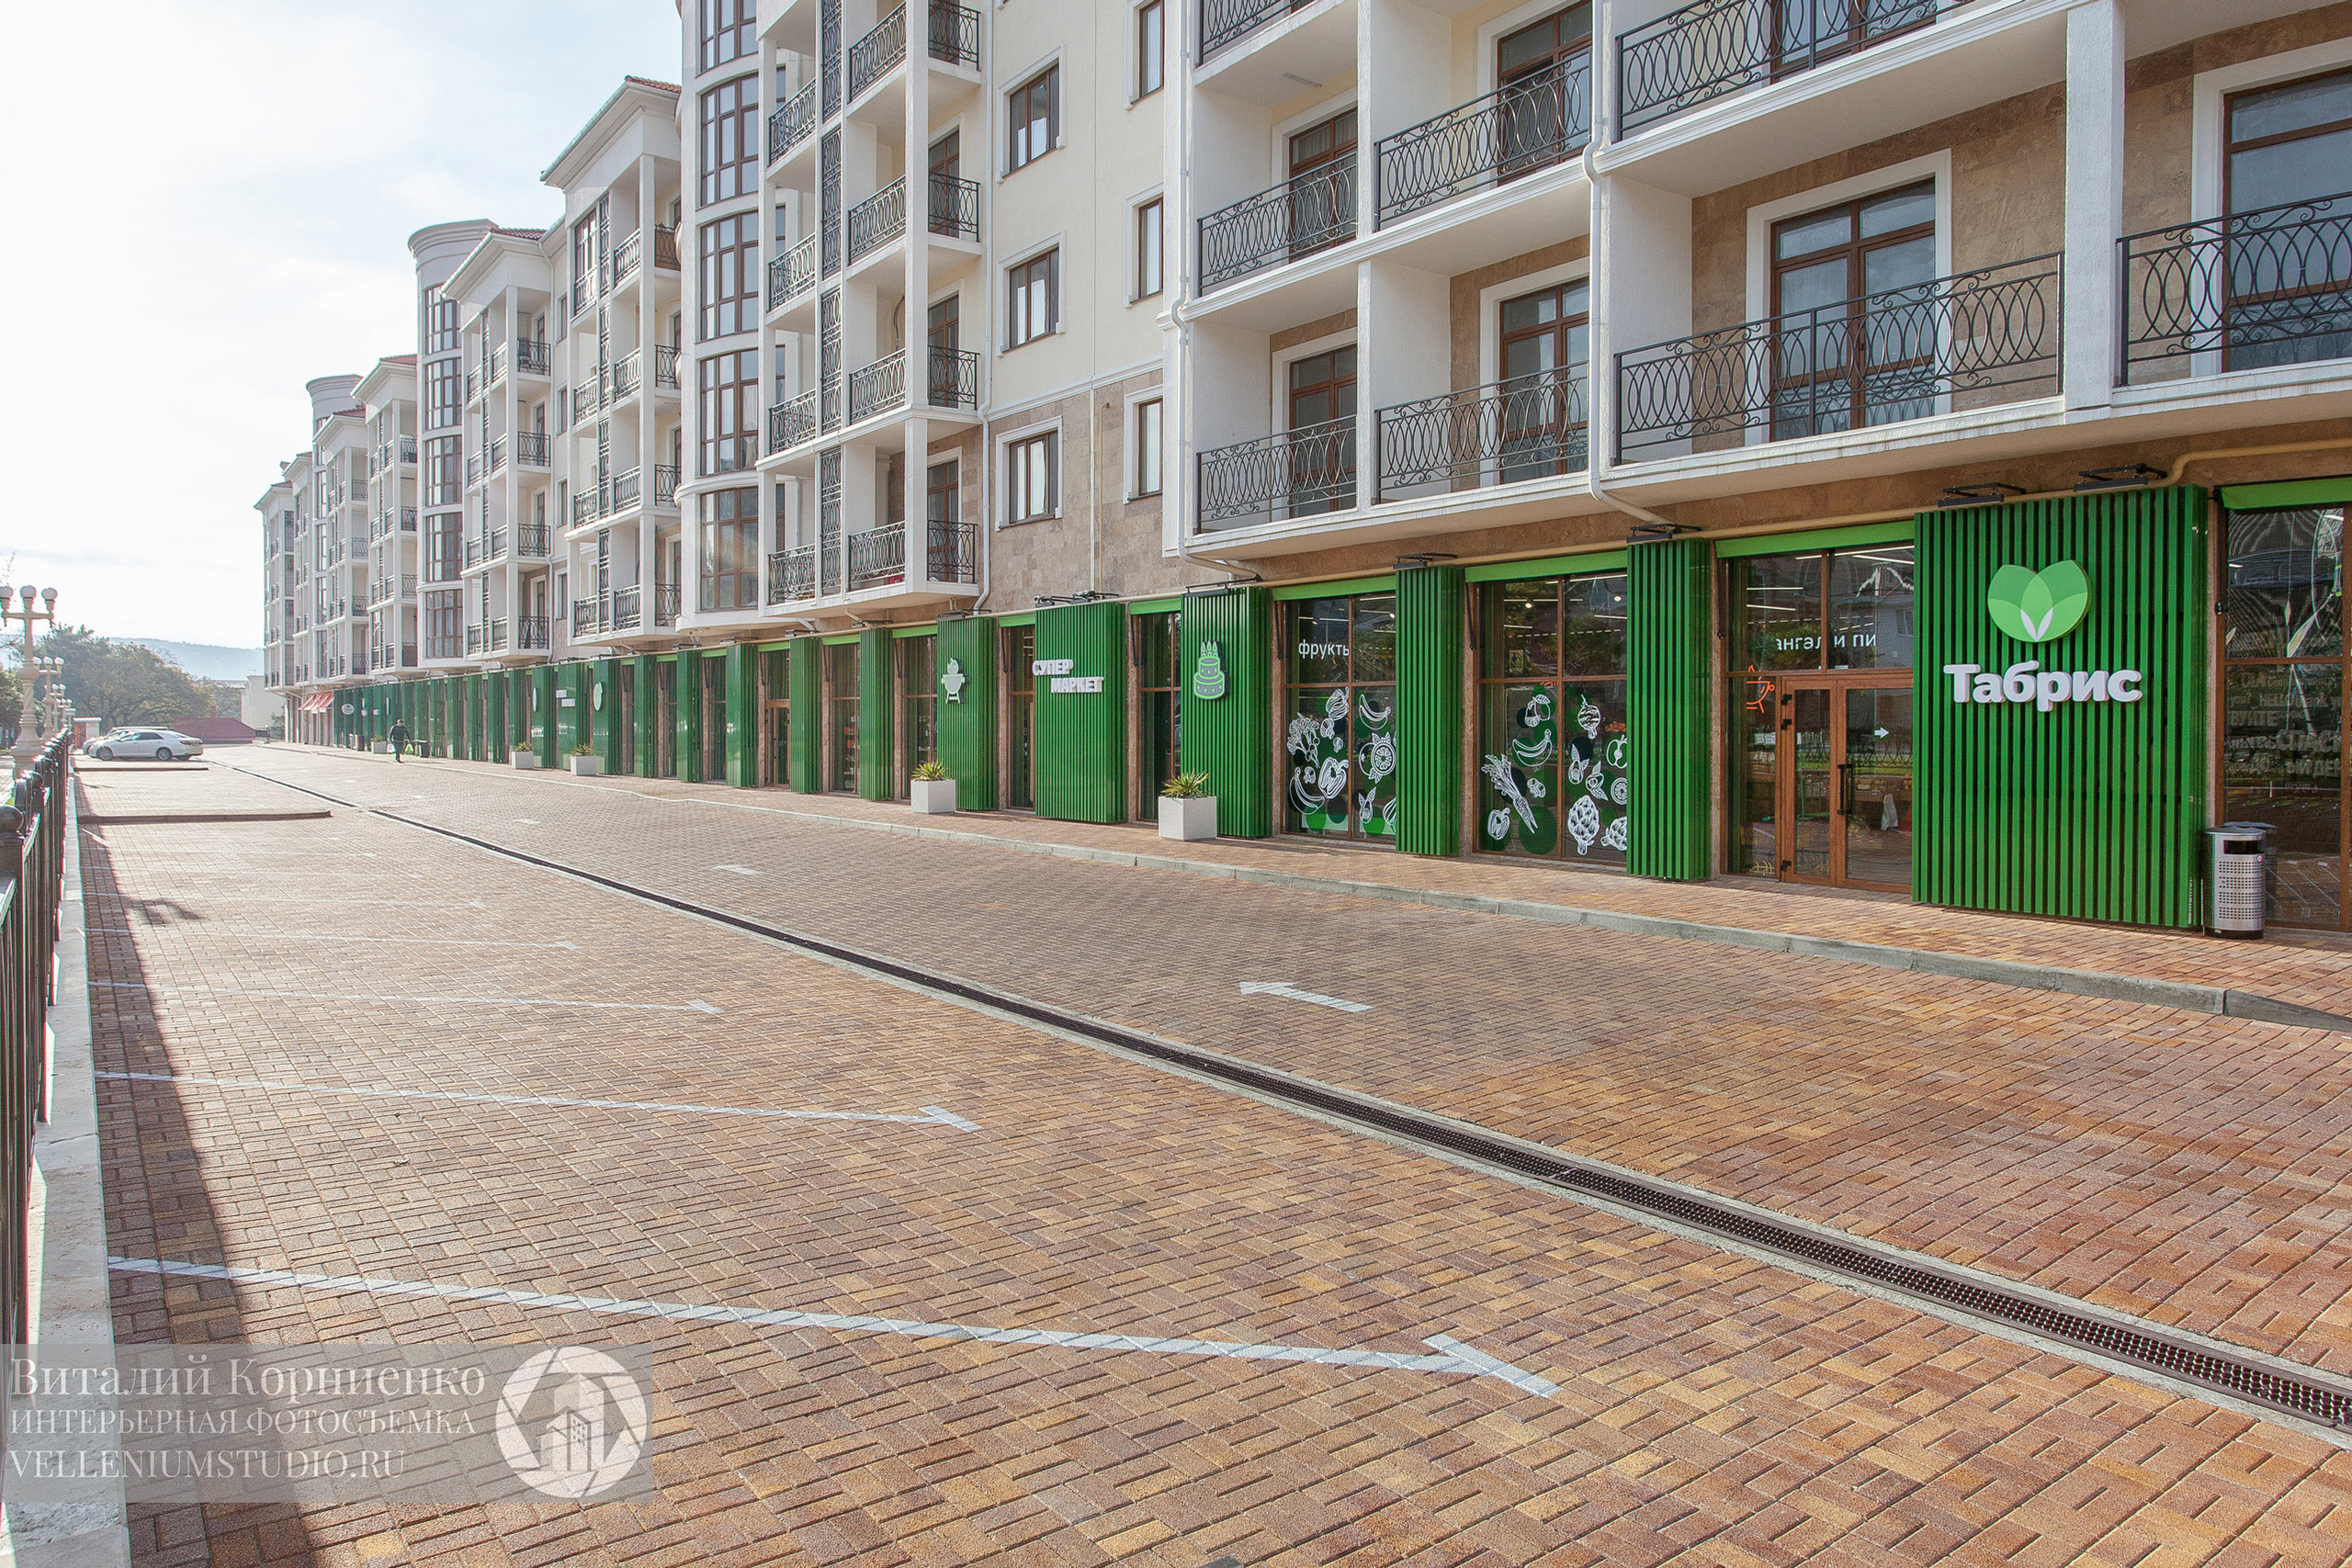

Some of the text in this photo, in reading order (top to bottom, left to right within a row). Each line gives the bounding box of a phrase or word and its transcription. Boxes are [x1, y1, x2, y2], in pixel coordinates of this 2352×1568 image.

[1834, 636, 1846, 649] и
[1032, 659, 1074, 676] СУПЕР
[1051, 676, 1104, 693] МАРКЕТ
[1943, 660, 2143, 712] Табрис
